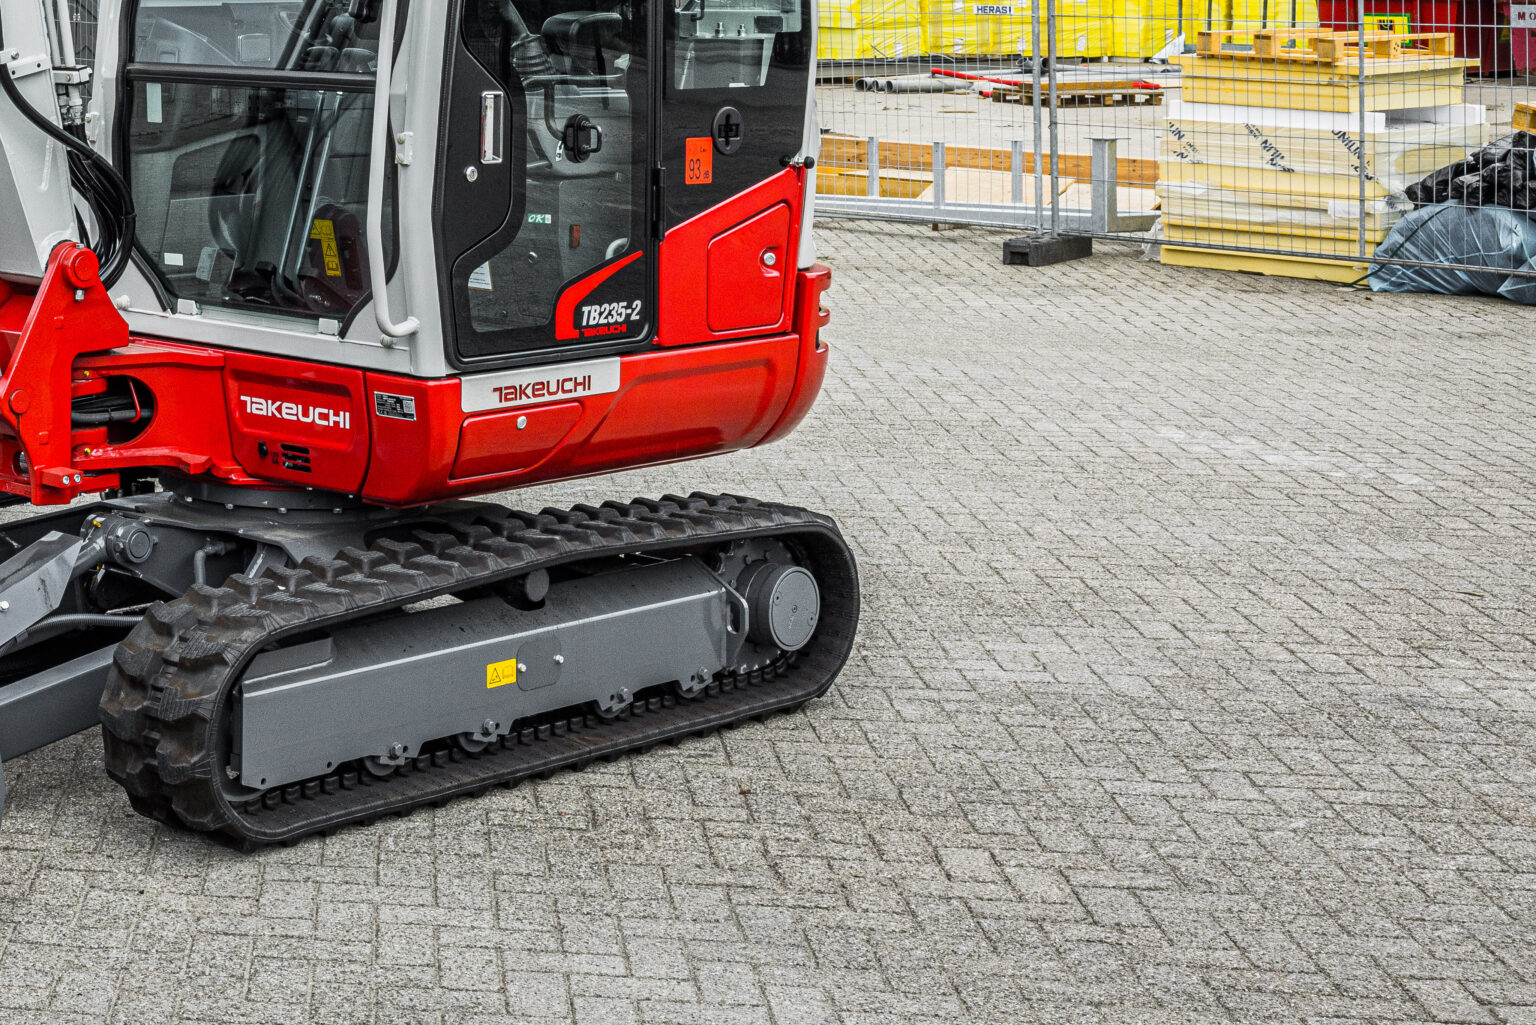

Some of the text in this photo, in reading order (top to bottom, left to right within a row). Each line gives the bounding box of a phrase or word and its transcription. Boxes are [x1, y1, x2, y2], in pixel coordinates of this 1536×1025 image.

[689, 158, 701, 180] 93
[528, 214, 545, 223] OK
[581, 300, 642, 326] TB235-2
